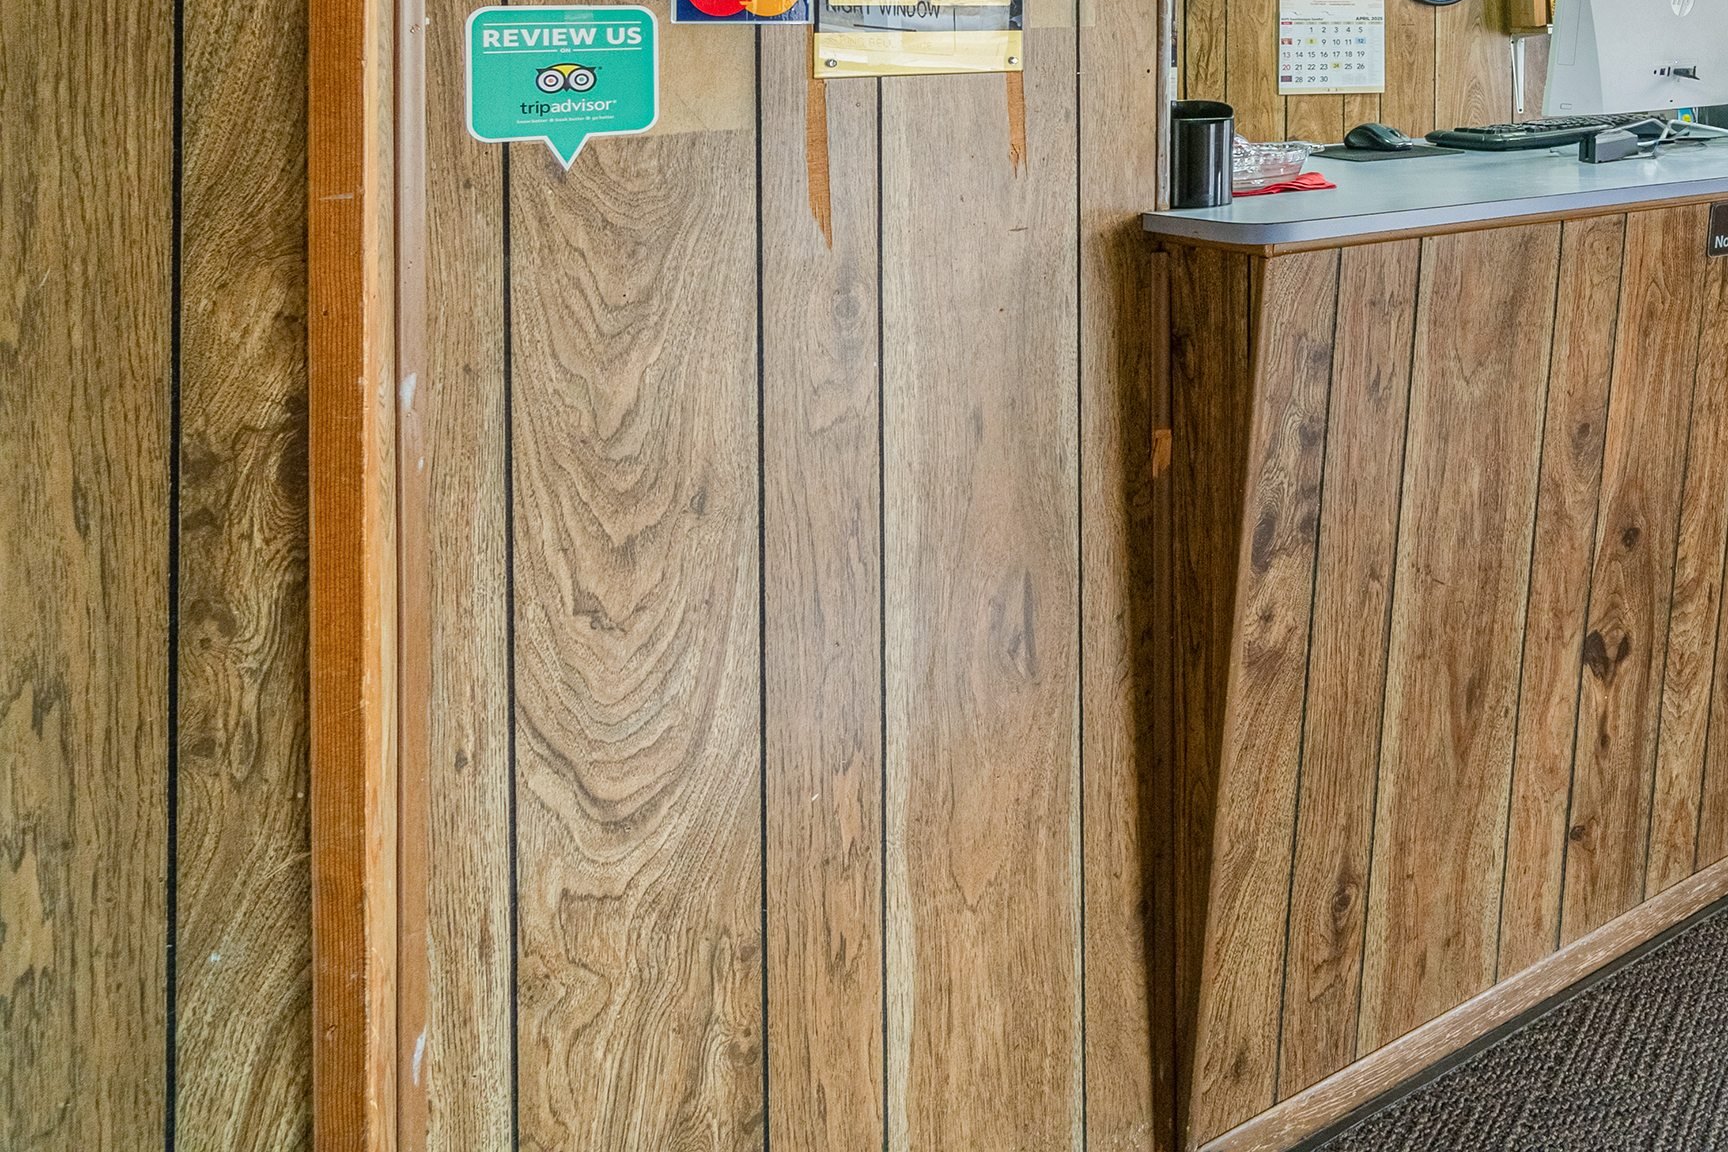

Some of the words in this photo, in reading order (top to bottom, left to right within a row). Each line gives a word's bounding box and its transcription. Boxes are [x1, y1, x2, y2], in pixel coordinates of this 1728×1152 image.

[482, 28, 597, 48] REVIEW
[606, 27, 642, 45] US
[520, 99, 612, 117] tripadvisor
